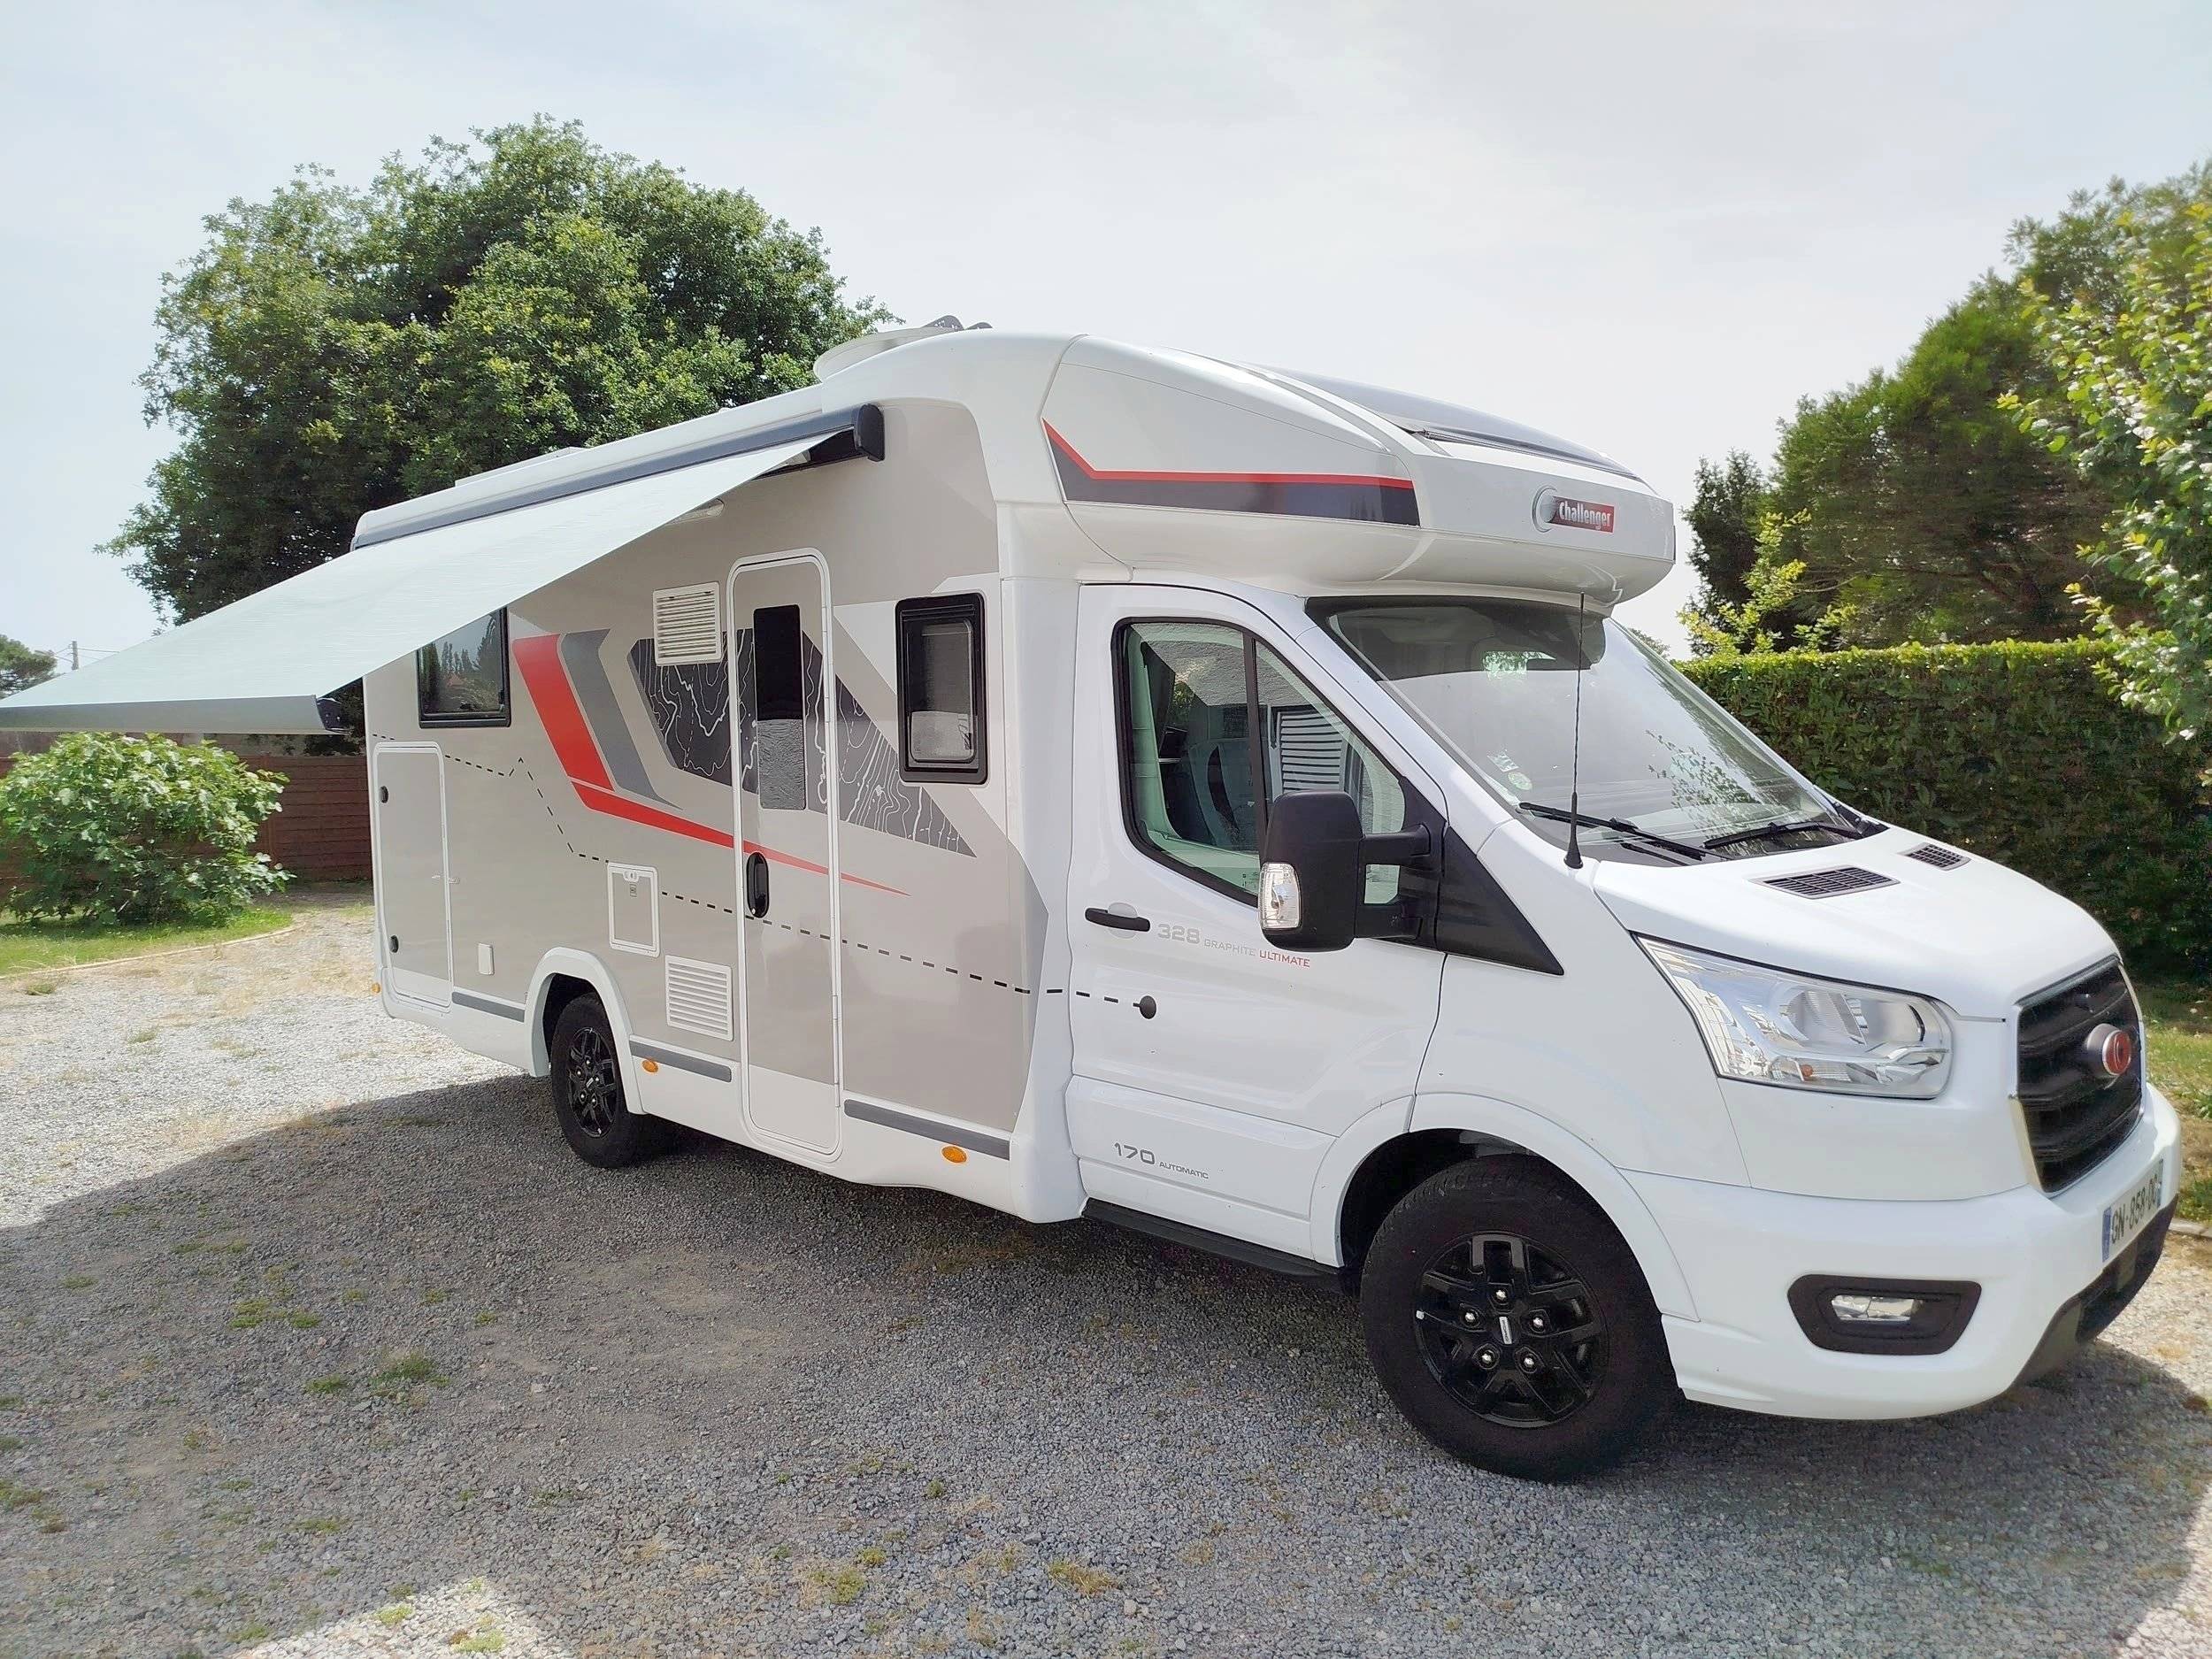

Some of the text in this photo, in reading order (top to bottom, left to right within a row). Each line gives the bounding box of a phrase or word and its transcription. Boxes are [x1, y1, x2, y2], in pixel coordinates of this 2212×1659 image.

[1559, 501, 1611, 529] Challenger
[1157, 923, 1310, 967] 328 GRAPHITE ULTIMATE
[1114, 1142, 1210, 1179] 170 AUTOMATIC
